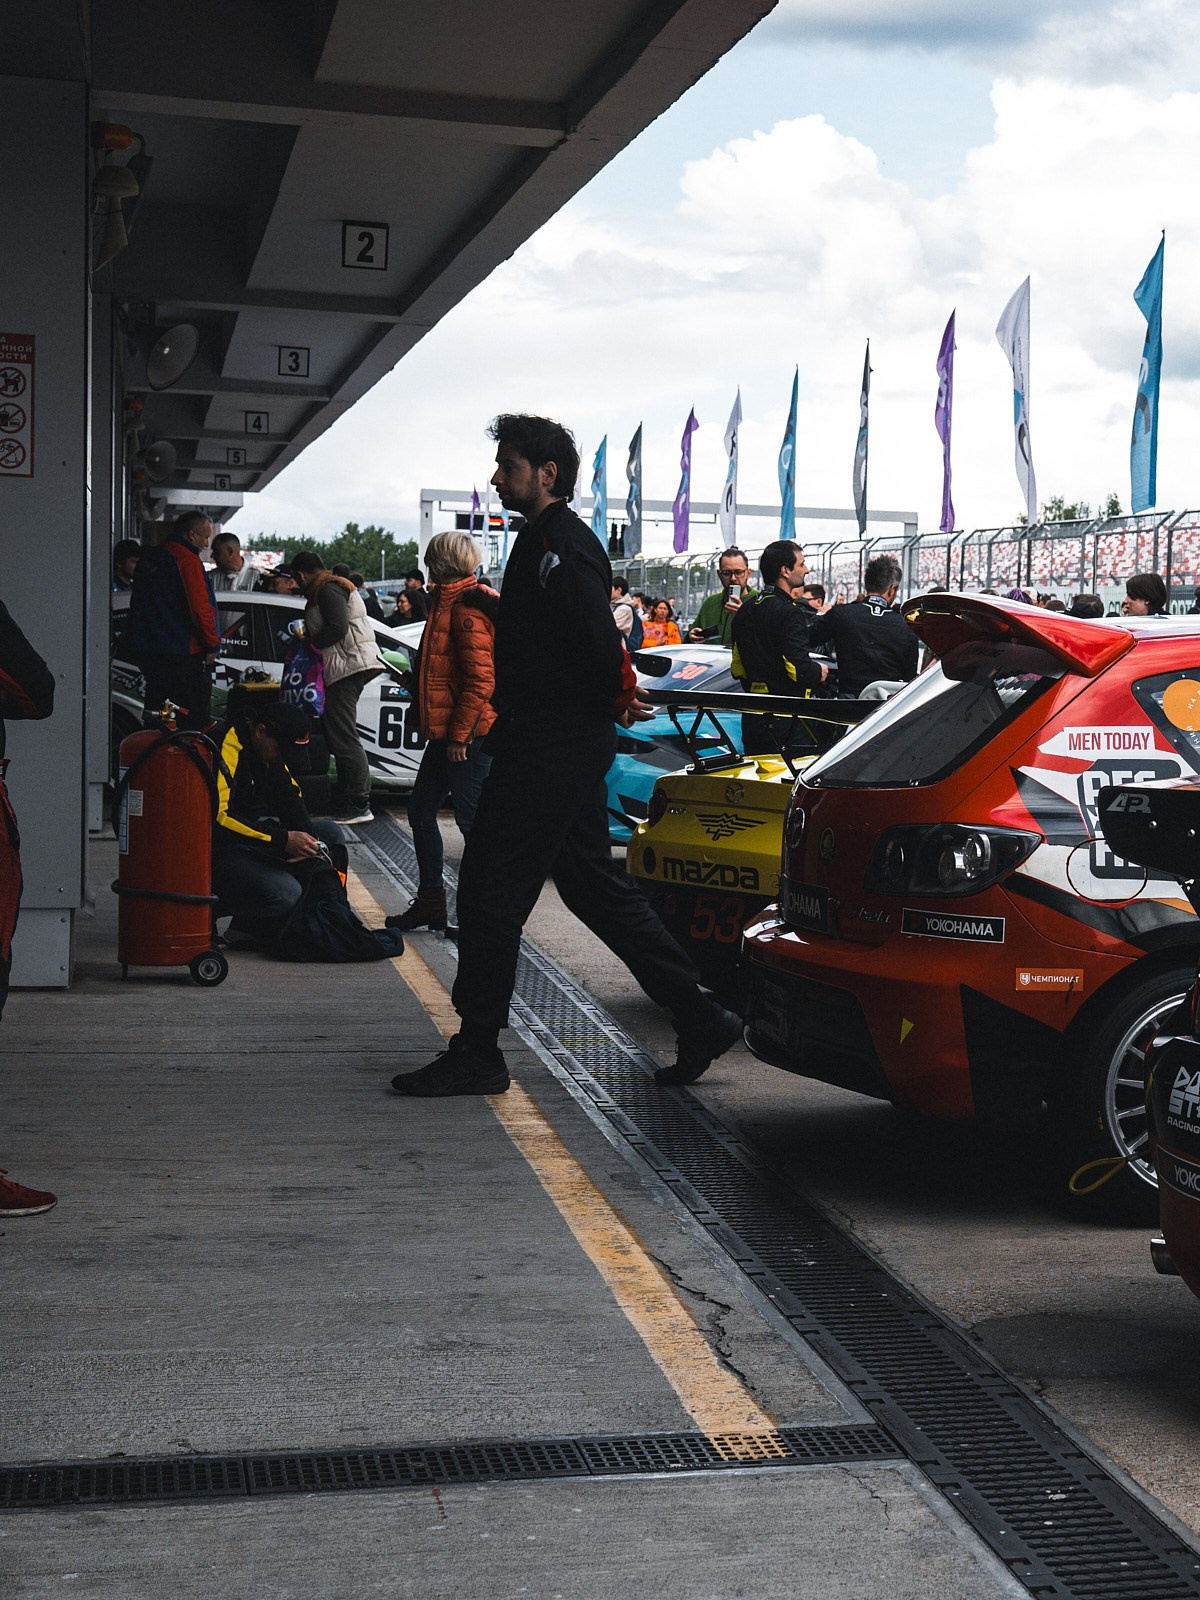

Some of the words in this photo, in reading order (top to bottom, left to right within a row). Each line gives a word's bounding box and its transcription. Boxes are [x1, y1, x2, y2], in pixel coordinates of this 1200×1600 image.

[356, 231, 375, 263] 2
[288, 351, 300, 372] 3
[252, 415, 262, 431] 4
[233, 452, 241, 463] 5
[219, 478, 226, 489] 6
[1068, 732, 1101, 751] MEN
[1104, 732, 1151, 751] TODAY
[689, 892, 745, 945] 53
[925, 917, 995, 938] YOKOHAMA
[1167, 1116, 1200, 1134] RACING
